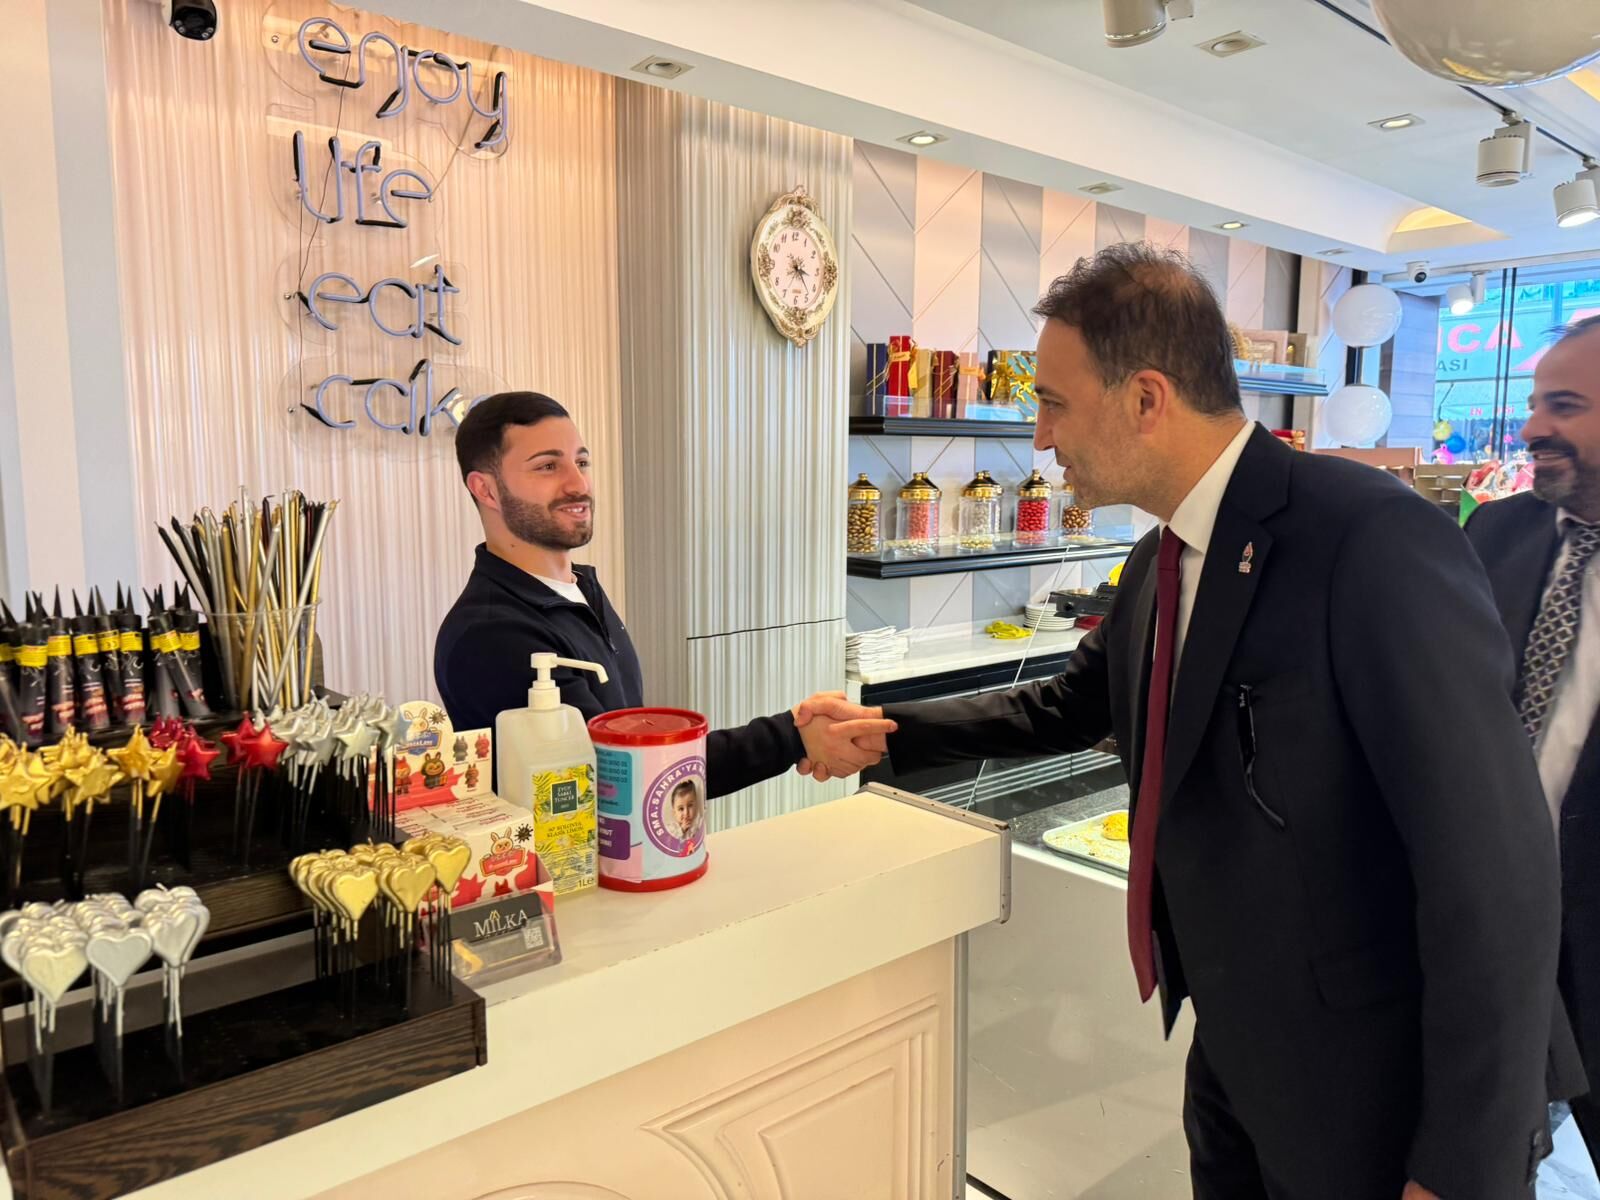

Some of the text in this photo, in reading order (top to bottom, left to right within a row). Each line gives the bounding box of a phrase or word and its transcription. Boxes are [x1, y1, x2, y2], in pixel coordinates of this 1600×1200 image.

[298, 17, 508, 149] enjoy
[293, 131, 433, 228] life
[781, 233, 787, 243] 11
[791, 231, 799, 242] 12
[810, 250, 816, 259] 2
[307, 264, 462, 345] eat
[794, 296, 799, 305] 6
[316, 358, 489, 436] cak
